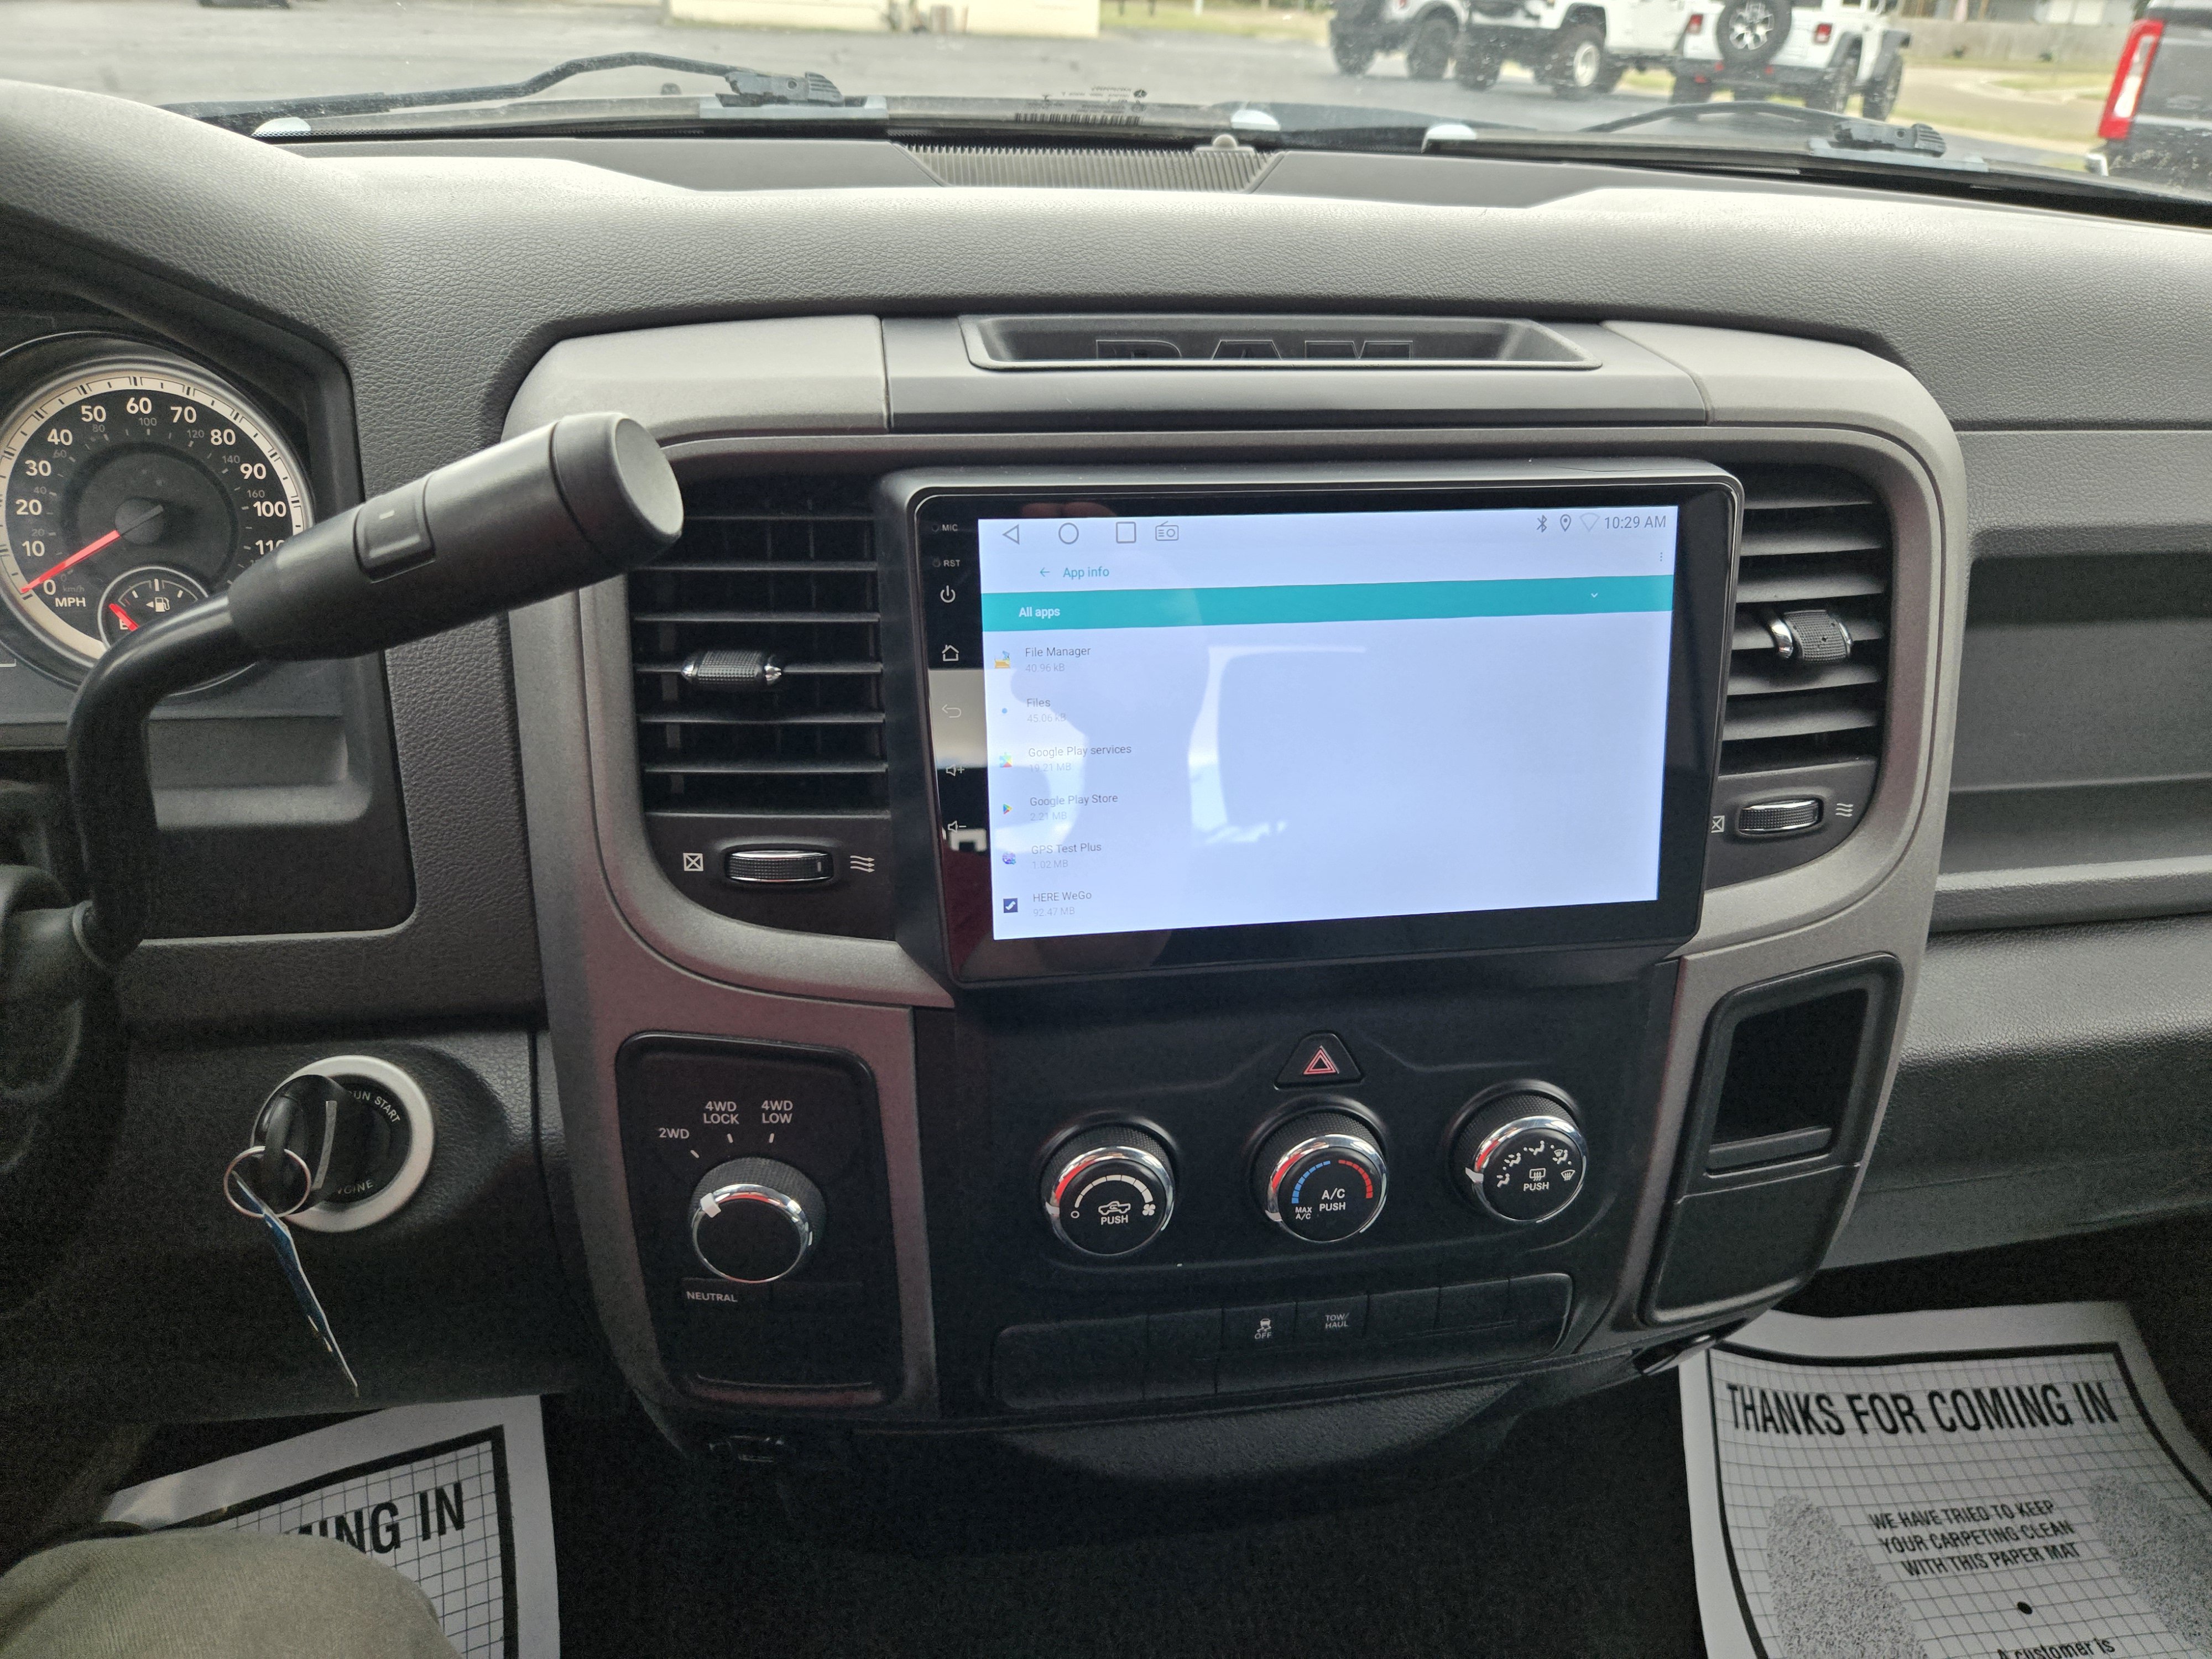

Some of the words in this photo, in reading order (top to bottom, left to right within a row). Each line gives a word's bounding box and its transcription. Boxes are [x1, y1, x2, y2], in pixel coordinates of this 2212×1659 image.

[126, 397, 152, 414] 60
[81, 405, 107, 422] 50
[170, 406, 197, 423] 70
[138, 418, 157, 426] 100
[92, 424, 105, 433] 80
[186, 429, 205, 439] 120
[47, 429, 73, 446] 40
[210, 429, 236, 445] 80
[222, 455, 240, 464] 140
[25, 460, 51, 477] 30
[239, 463, 267, 479] 90
[33, 486, 47, 494] 40
[247, 489, 265, 498] 160
[15, 499, 42, 515] 20
[253, 501, 286, 517] 100
[1604, 516, 1640, 529] 10:29
[1644, 515, 1667, 529] AM
[32, 528, 45, 536] 20
[942, 524, 958, 532] MIC
[22, 541, 45, 556] 10
[943, 559, 961, 567] RST
[1063, 567, 1084, 580] App
[1087, 566, 1110, 577] info
[43, 579, 56, 596] 0
[55, 597, 86, 608] MPH
[1018, 607, 1032, 618] All
[1035, 608, 1061, 620] apps
[1025, 647, 1044, 658] File
[1047, 646, 1092, 660] Manager
[1025, 663, 1050, 672] 40.96
[1053, 662, 1065, 672] kB
[1026, 697, 1051, 708] Files
[1026, 713, 1053, 723] 45.06
[1055, 712, 1067, 722] kB
[1028, 747, 1063, 759] Google
[1066, 745, 1088, 758] Play
[1091, 744, 1132, 755] services
[1029, 764, 1053, 773] 19.21
[1056, 763, 1072, 771] MB
[1030, 796, 1065, 808] Google
[1067, 795, 1089, 807] Play
[1092, 794, 1118, 804] Store
[1030, 812, 1050, 821] 2.21
[1052, 811, 1067, 820] MB
[1031, 844, 1053, 855] GPS
[1056, 843, 1077, 853] Test
[1080, 842, 1102, 852] Plus
[1032, 860, 1051, 869] 1.02
[1053, 859, 1068, 868] MB
[1032, 893, 1060, 902] HERE
[1062, 891, 1092, 901] WeGo
[1033, 907, 1058, 917] 92.47
[1060, 906, 1075, 916] MB
[348, 1091, 371, 1101] UN
[374, 1096, 400, 1123] START
[705, 1101, 737, 1112] 4WD
[761, 1100, 793, 1112] 4WD
[703, 1113, 739, 1124] LOCK
[762, 1113, 792, 1124] LOW
[659, 1128, 690, 1139] 2WD
[1524, 1182, 1550, 1191] PUSH
[1322, 1188, 1345, 1201] A/C
[1319, 1202, 1346, 1212] PUSH
[1100, 1214, 1129, 1225] PUSH
[686, 1291, 738, 1303] NEUTRAL
[1325, 1313, 1349, 1322] TOW/
[1325, 1320, 1348, 1329] HAUL
[1254, 1331, 1272, 1339] OFF
[1726, 1383, 1845, 1436] THANKS
[1846, 1393, 1927, 1434] FOR
[1929, 1383, 2073, 1433] COMING
[2073, 1382, 2119, 1424] IN
[419, 1481, 465, 1542] IN
[1869, 1513, 1898, 1530] WE
[1898, 1510, 1942, 1528] HAVE
[1940, 1506, 1990, 1524] TRIED
[1990, 1504, 2015, 1520] TO
[2015, 1500, 2054, 1517] KEEP
[1880, 1535, 1929, 1554] YOUR
[1929, 1526, 2020, 1550] CARPETING
[2021, 1520, 2075, 1539] CLEAN
[1901, 1557, 1949, 1577] WITH
[1949, 1553, 1989, 1572] THIS
[1989, 1548, 2043, 1567] PAPER
[2043, 1542, 2080, 1560] MAT
[2015, 1641, 2095, 1659] customer
[2094, 1638, 2116, 1653] is
